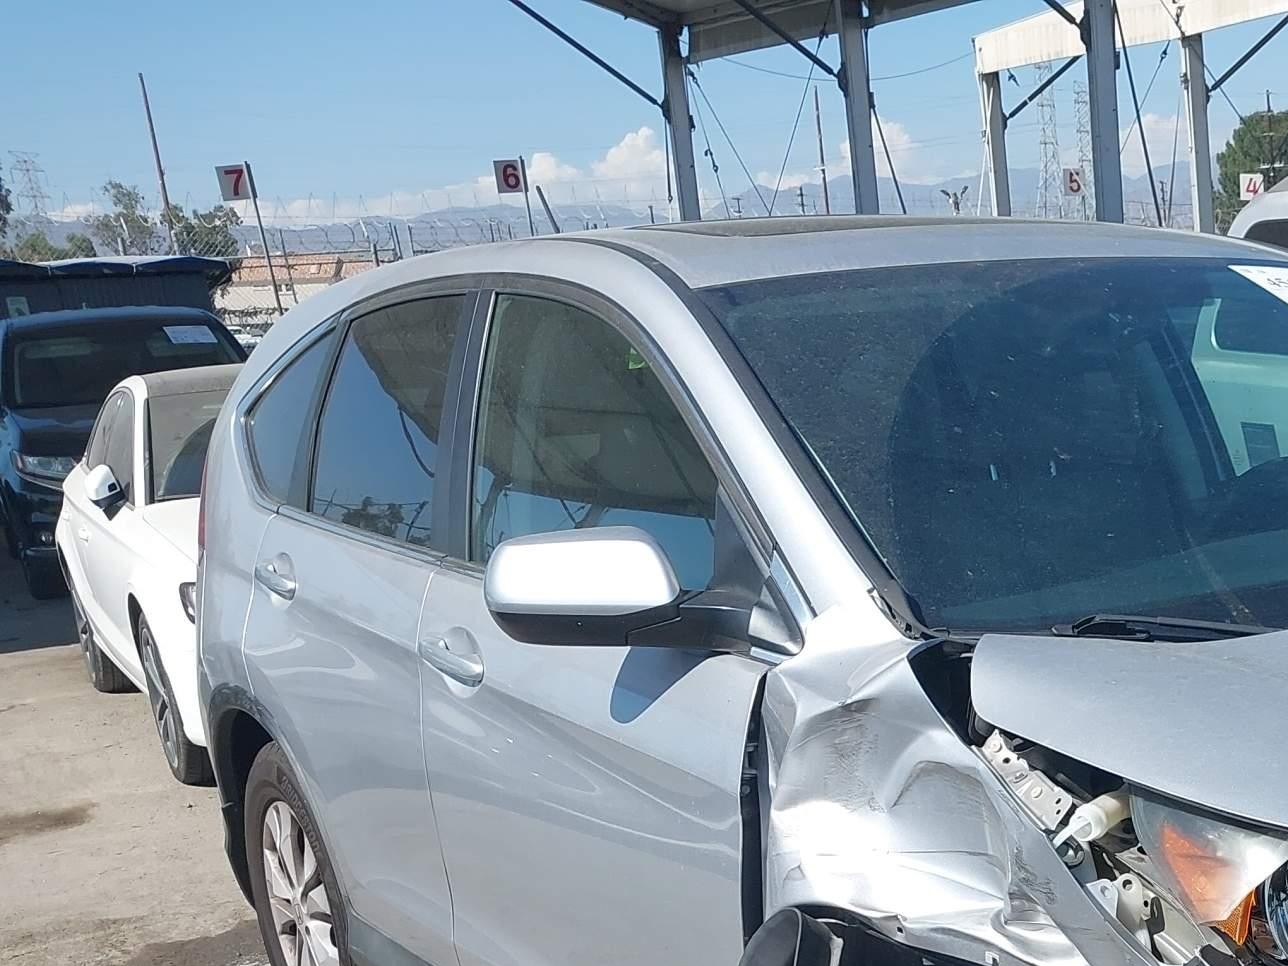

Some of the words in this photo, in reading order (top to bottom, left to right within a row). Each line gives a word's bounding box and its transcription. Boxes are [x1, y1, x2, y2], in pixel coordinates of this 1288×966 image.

[223, 169, 244, 196] 7
[502, 163, 520, 189] 6
[1068, 171, 1081, 193] 5
[1246, 177, 1259, 195] 4
